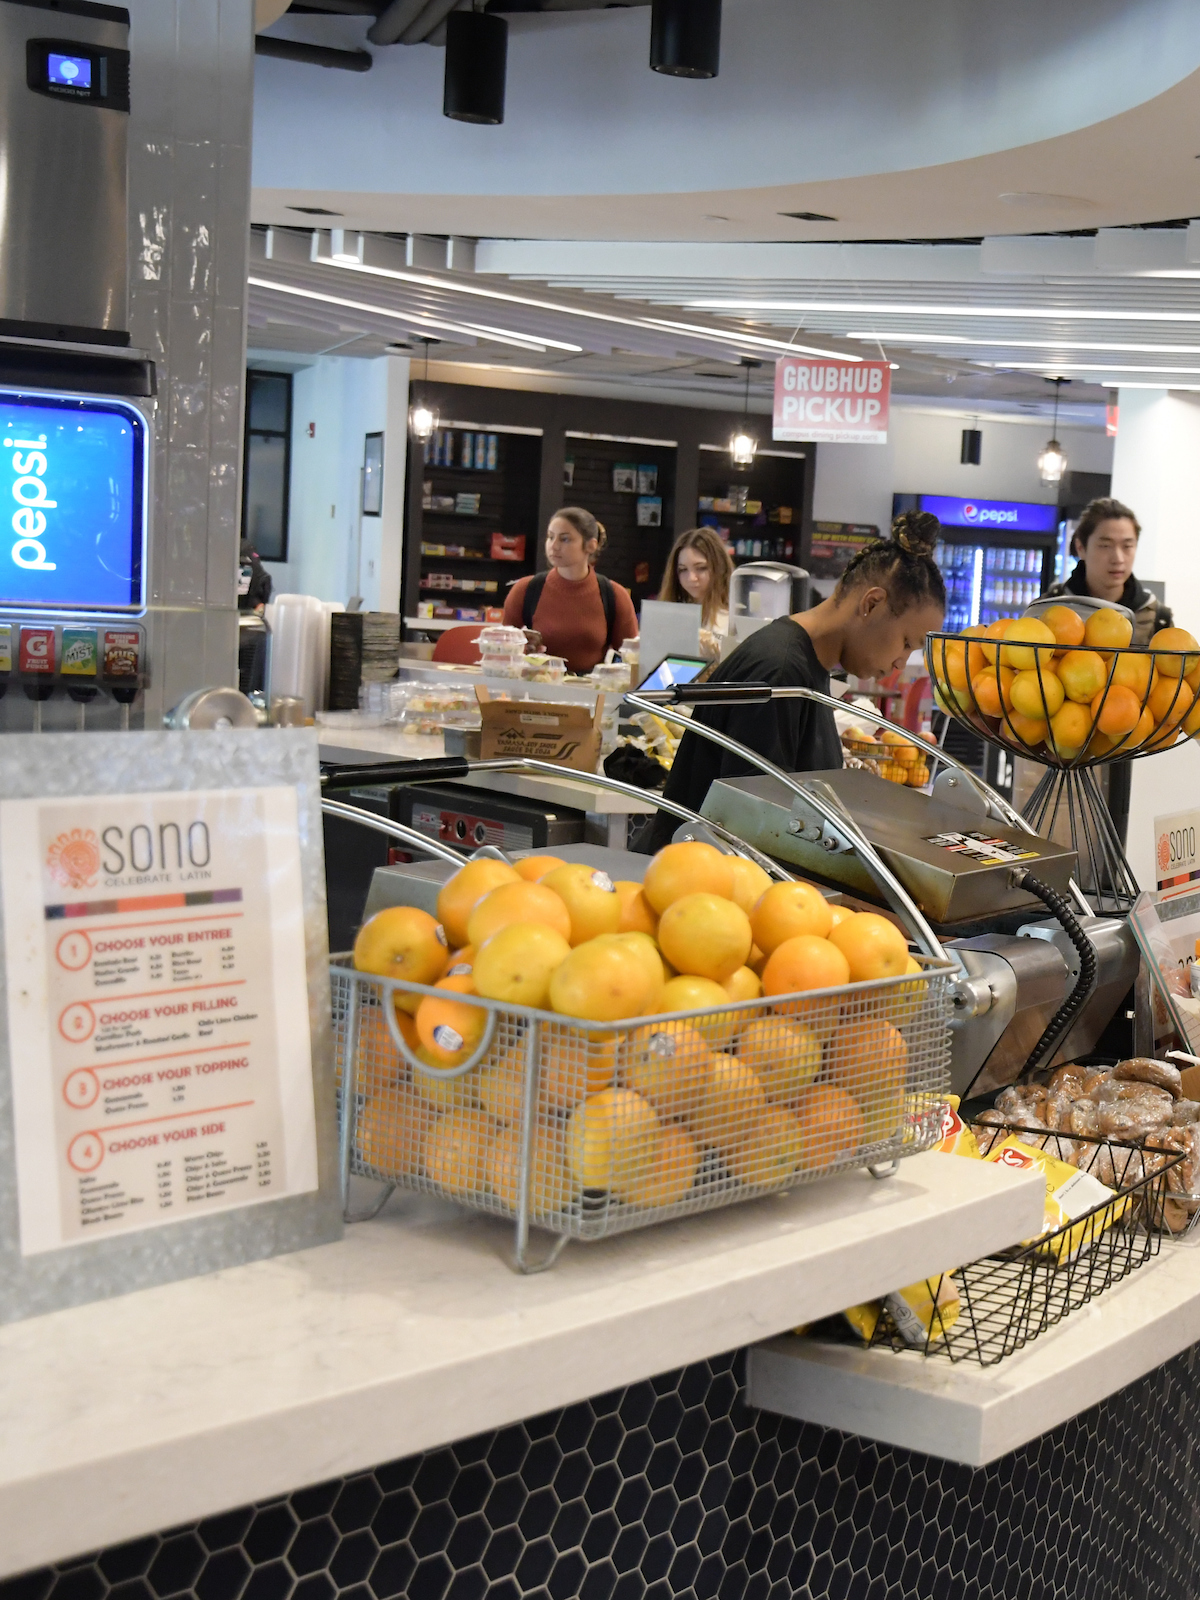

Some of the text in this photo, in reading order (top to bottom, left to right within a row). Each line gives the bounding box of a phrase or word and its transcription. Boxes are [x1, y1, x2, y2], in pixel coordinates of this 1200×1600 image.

[783, 366, 882, 393] GRUBHUB
[782, 396, 881, 424] PICKUP
[3, 437, 58, 571] pepsi
[980, 508, 1018, 524] pepsi
[66, 648, 92, 662] MIST
[109, 651, 135, 660] MUG
[102, 821, 211, 875] sono
[1170, 826, 1196, 862] sono
[104, 870, 212, 888] CELEBRATE LATIN
[95, 938, 146, 952] CHOOSE
[150, 933, 184, 948] YOUR
[188, 928, 232, 943] ENTREE
[100, 1008, 150, 1025] CHOOSE
[154, 1003, 188, 1018] YOUR
[192, 996, 238, 1012] FILLING
[104, 1074, 153, 1090] CHOOSE
[158, 1068, 192, 1082] YOUR
[195, 1058, 249, 1075] TOPPING
[109, 1137, 160, 1154] CHOOSE
[164, 1130, 198, 1142] YOUR
[202, 1122, 226, 1136] SIDE
